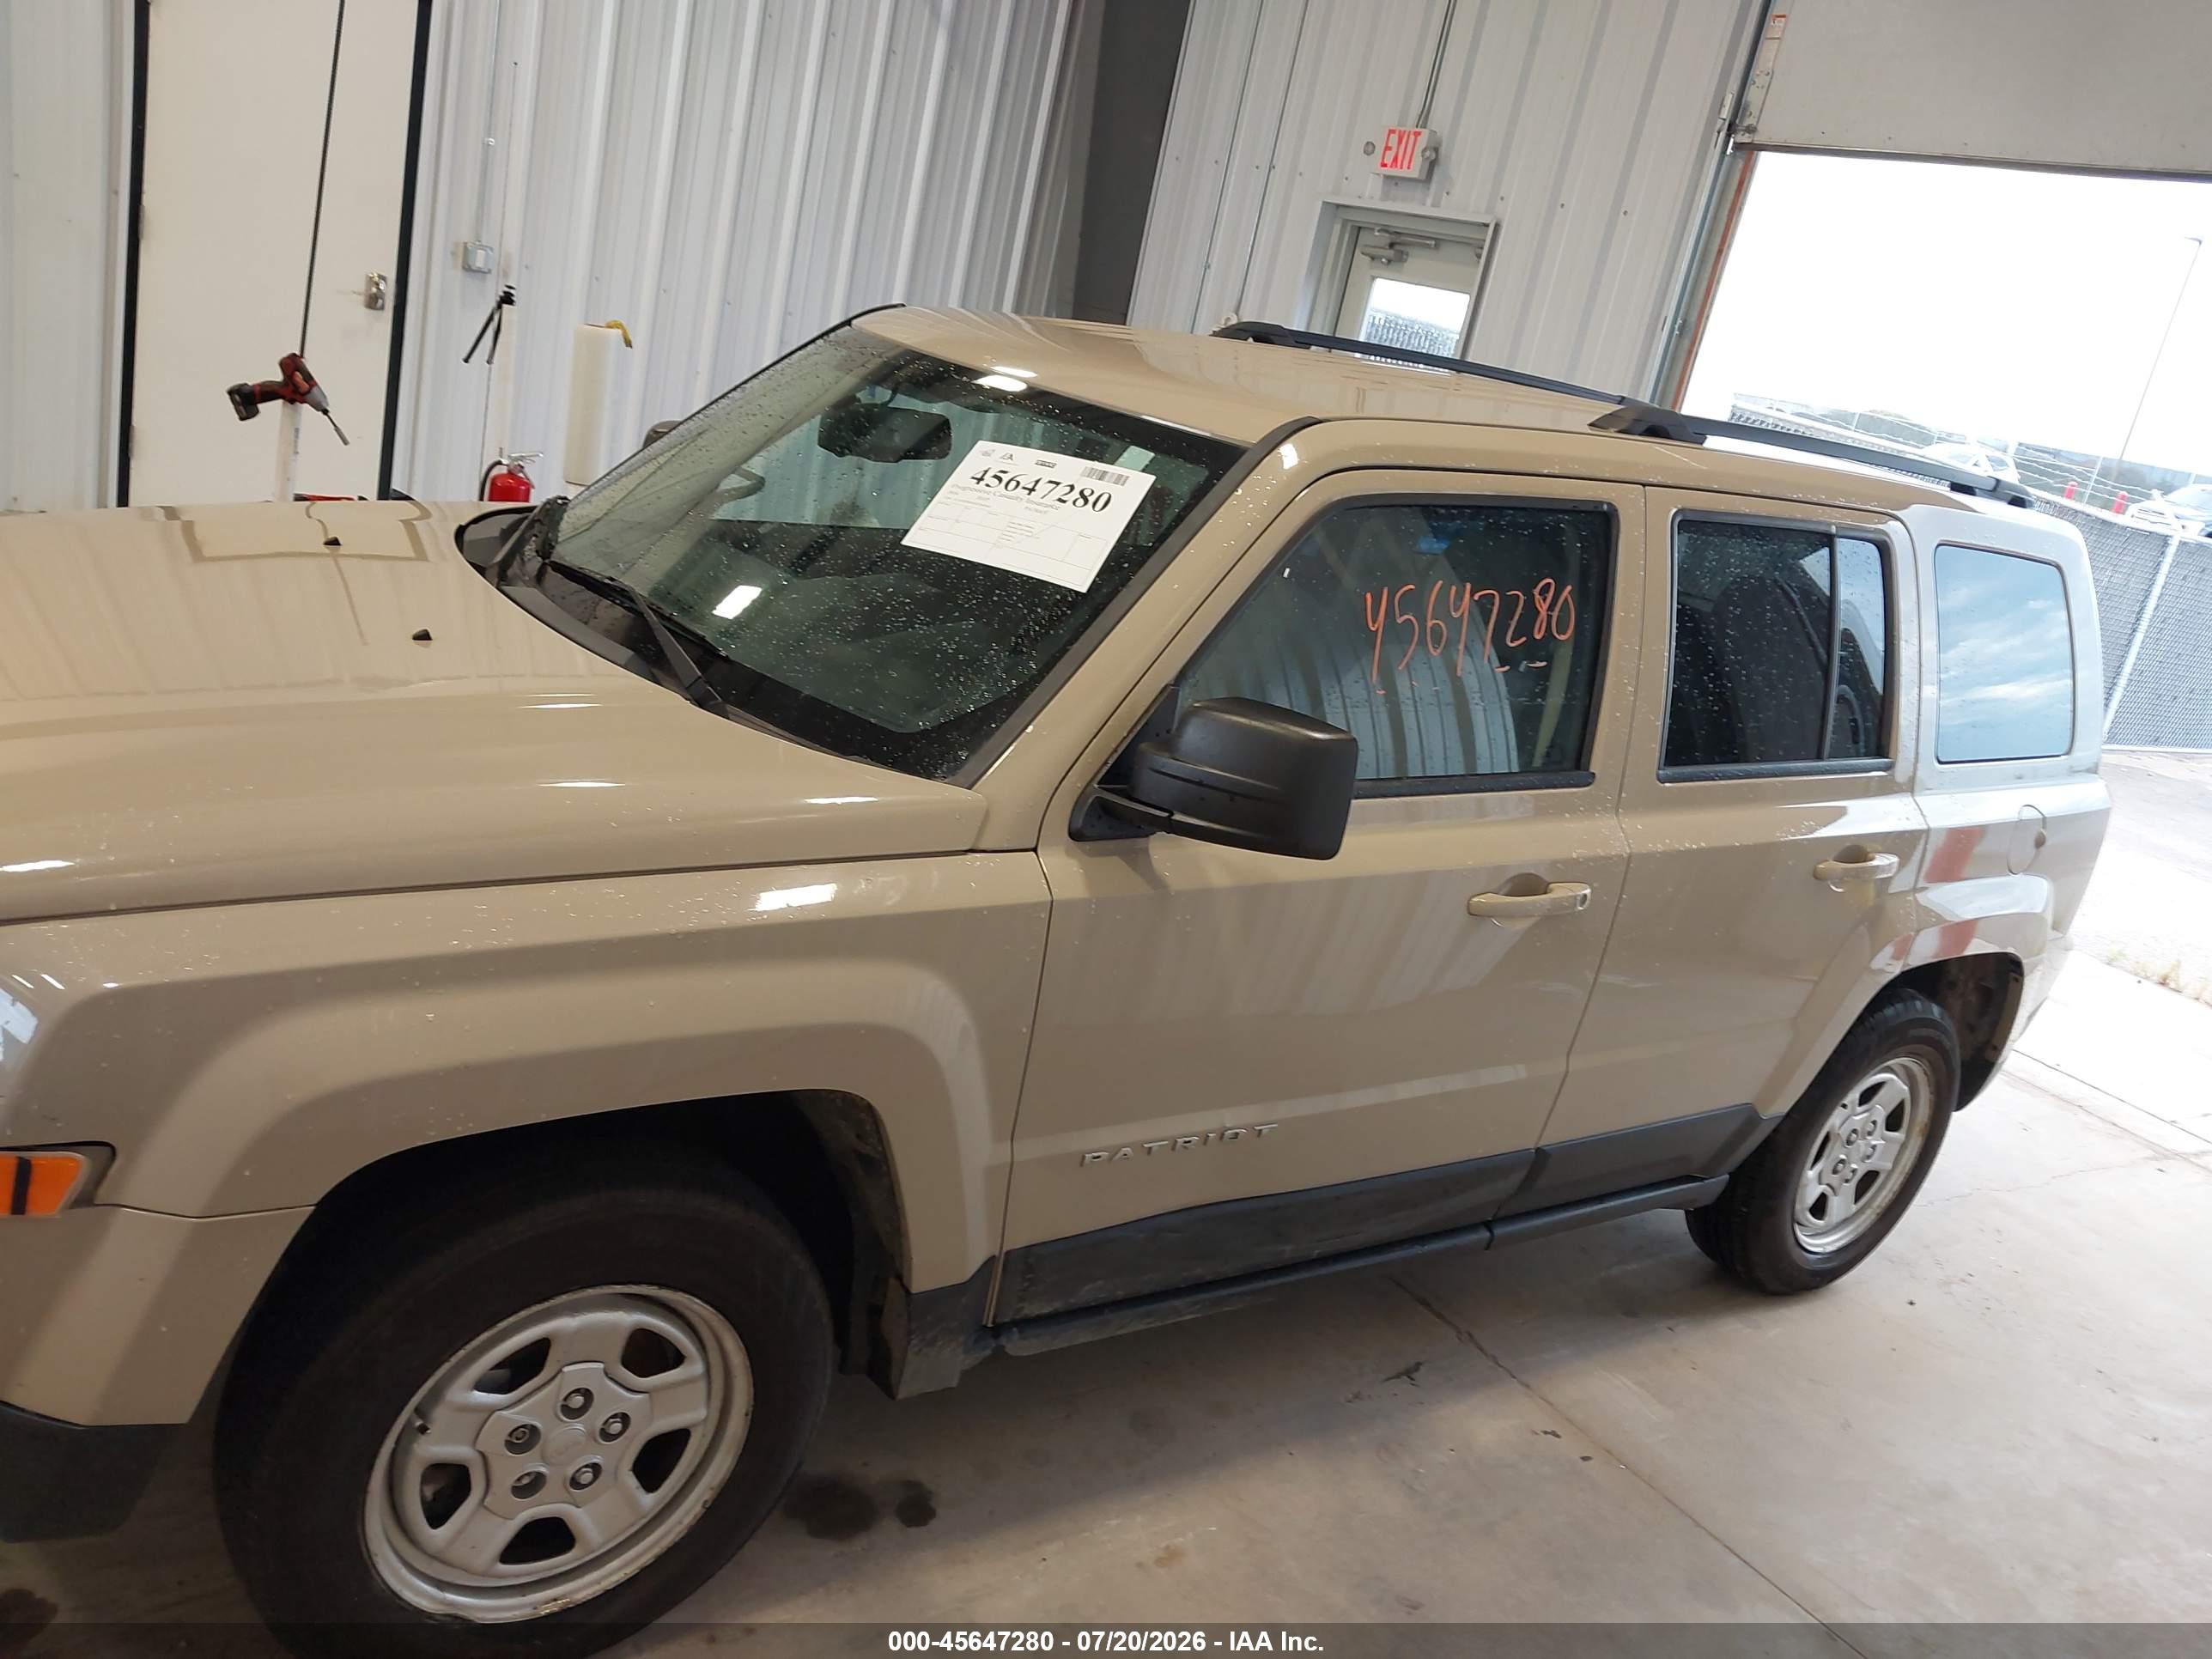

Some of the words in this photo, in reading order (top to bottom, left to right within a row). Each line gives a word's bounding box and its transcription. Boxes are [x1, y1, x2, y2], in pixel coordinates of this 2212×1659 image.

[1380, 128, 1423, 170] EXIT
[969, 466, 1114, 514] 45647280
[1364, 577, 1576, 684] 45647280
[1079, 1122, 1279, 1168] PATRIOT
